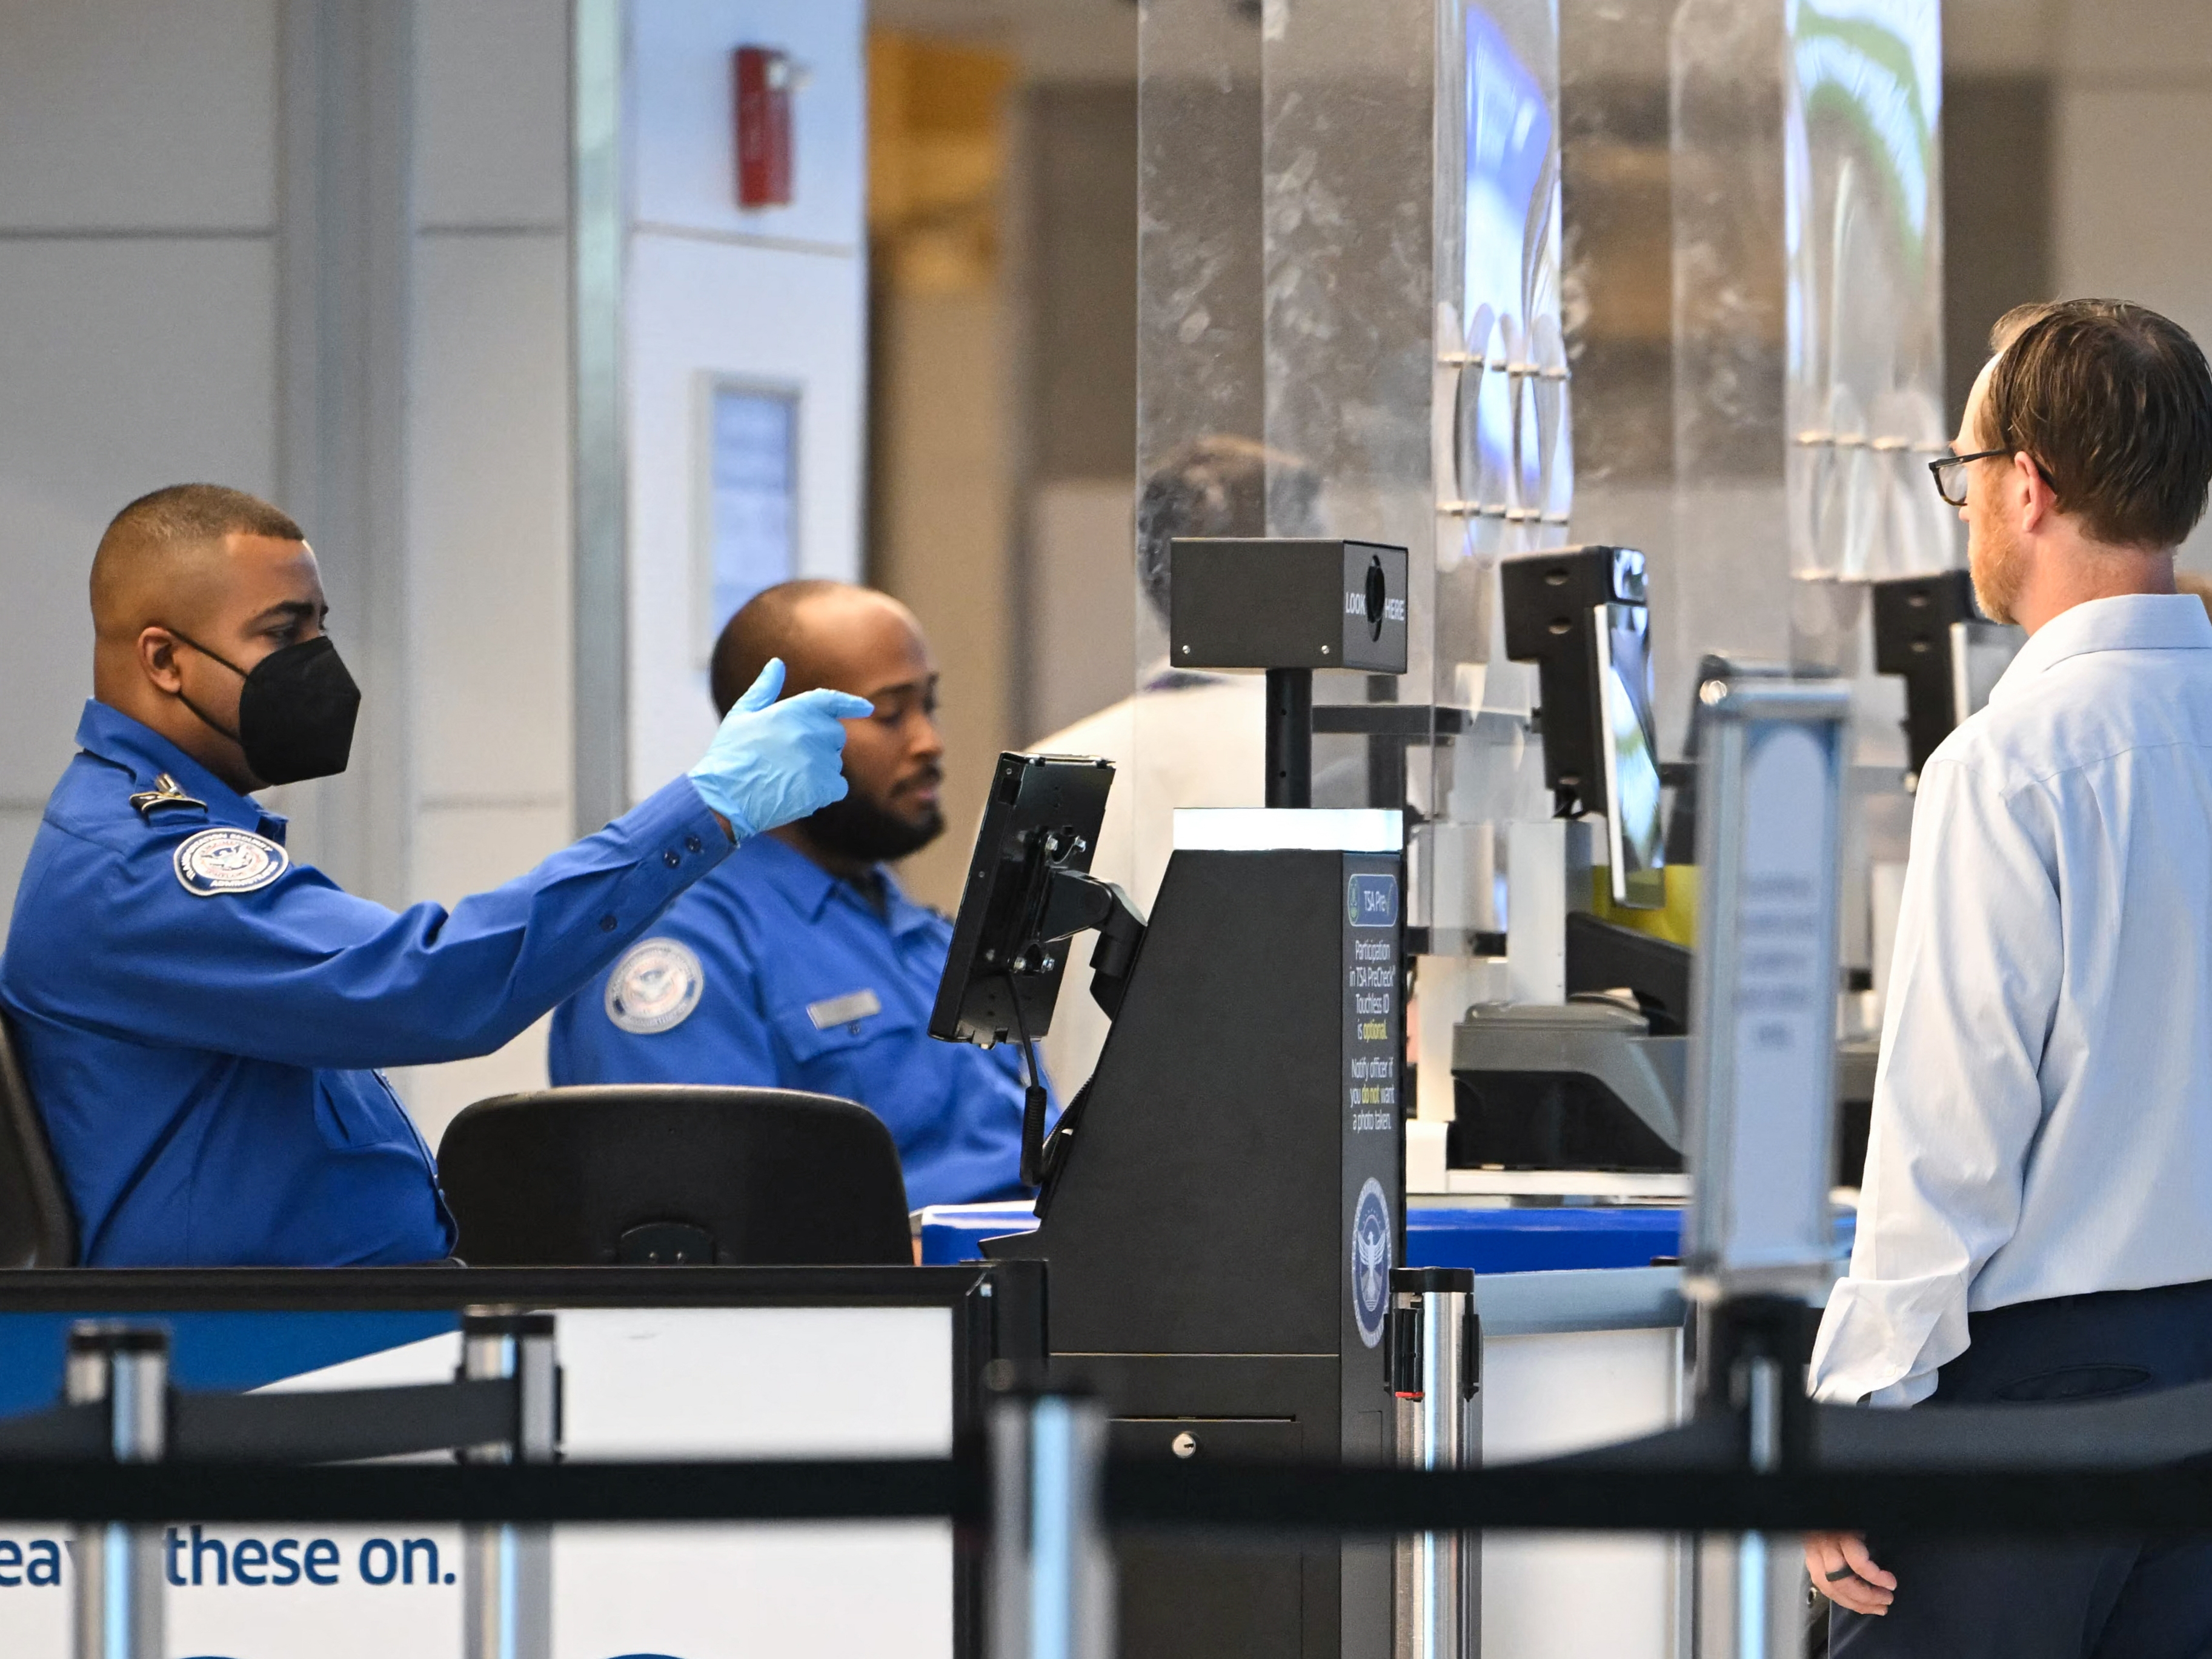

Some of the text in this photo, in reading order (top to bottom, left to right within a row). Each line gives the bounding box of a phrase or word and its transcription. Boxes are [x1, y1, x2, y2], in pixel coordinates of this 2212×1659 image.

[1346, 592, 1404, 621] LOOK HERE
[1364, 891, 1375, 911] TSA
[1355, 939, 1390, 963] Participation
[1349, 966, 1355, 987] in
[1356, 966, 1367, 987] TSA
[1355, 993, 1389, 1014] Touchless ID
[1358, 1019, 1363, 1040] is
[1352, 1057, 1393, 1082] Notify officer if
[1350, 1083, 1395, 1108] you do not want
[1353, 1114, 1357, 1131] a
[1358, 1109, 1374, 1134] photo
[165, 1524, 340, 1586] these
[359, 1538, 456, 1585] on.
